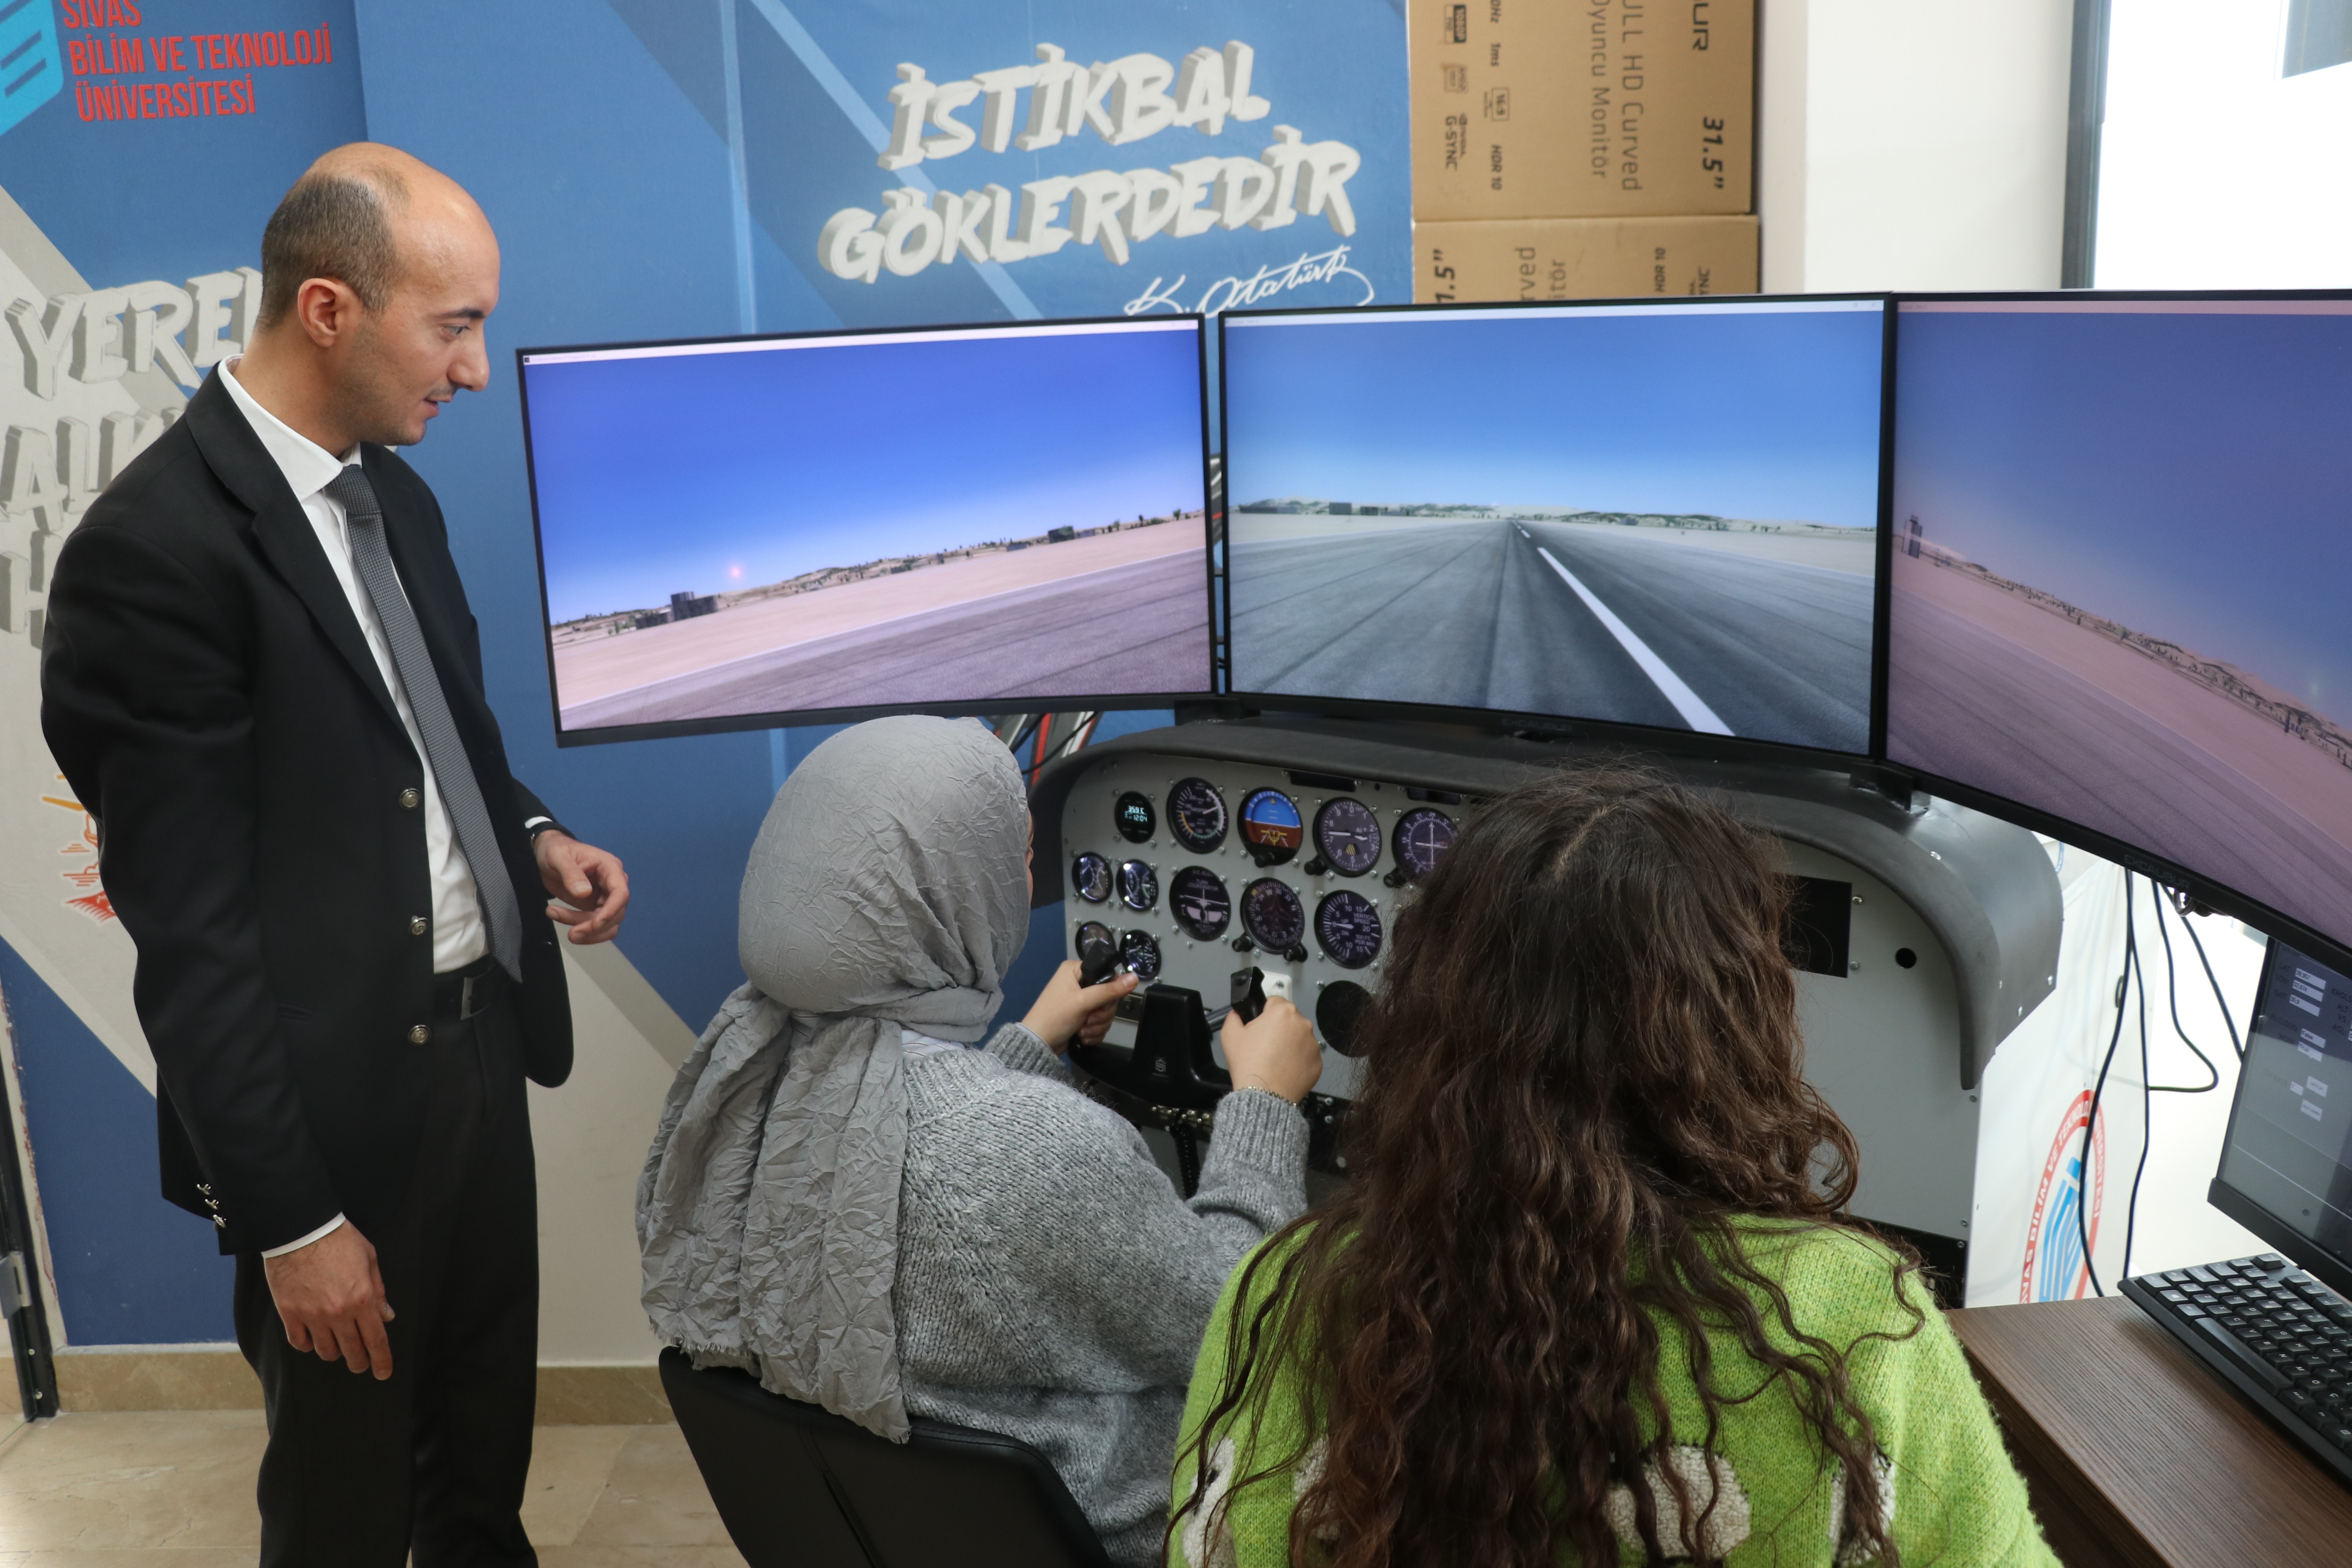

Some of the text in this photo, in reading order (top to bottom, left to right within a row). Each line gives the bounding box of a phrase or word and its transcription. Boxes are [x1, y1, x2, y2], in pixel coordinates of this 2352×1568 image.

[68, 23, 333, 76] BİLİM VE TEKNOLOJİ
[1490, 42, 1502, 67] 1ms
[75, 73, 256, 122] ÜNİVERSİTESİ
[878, 40, 1271, 171] İSTİKBAL
[1622, 0, 1644, 191] ULL HD Curved
[1445, 115, 1457, 172] G-SYNC
[1591, 87, 1611, 178] Monitör
[1491, 144, 1502, 191] HDR 10
[817, 124, 1362, 285] GÖKLERDEDİR
[1515, 247, 1536, 301] rved
[1549, 259, 1566, 299] itör
[1698, 266, 1710, 295] YNC
[1187, 882, 1219, 891] COORDINATOR
[2124, 855, 2190, 889] EXCALIBUR
[1353, 912, 1376, 921] VERTICAL
[2047, 1147, 2059, 1173] VE
